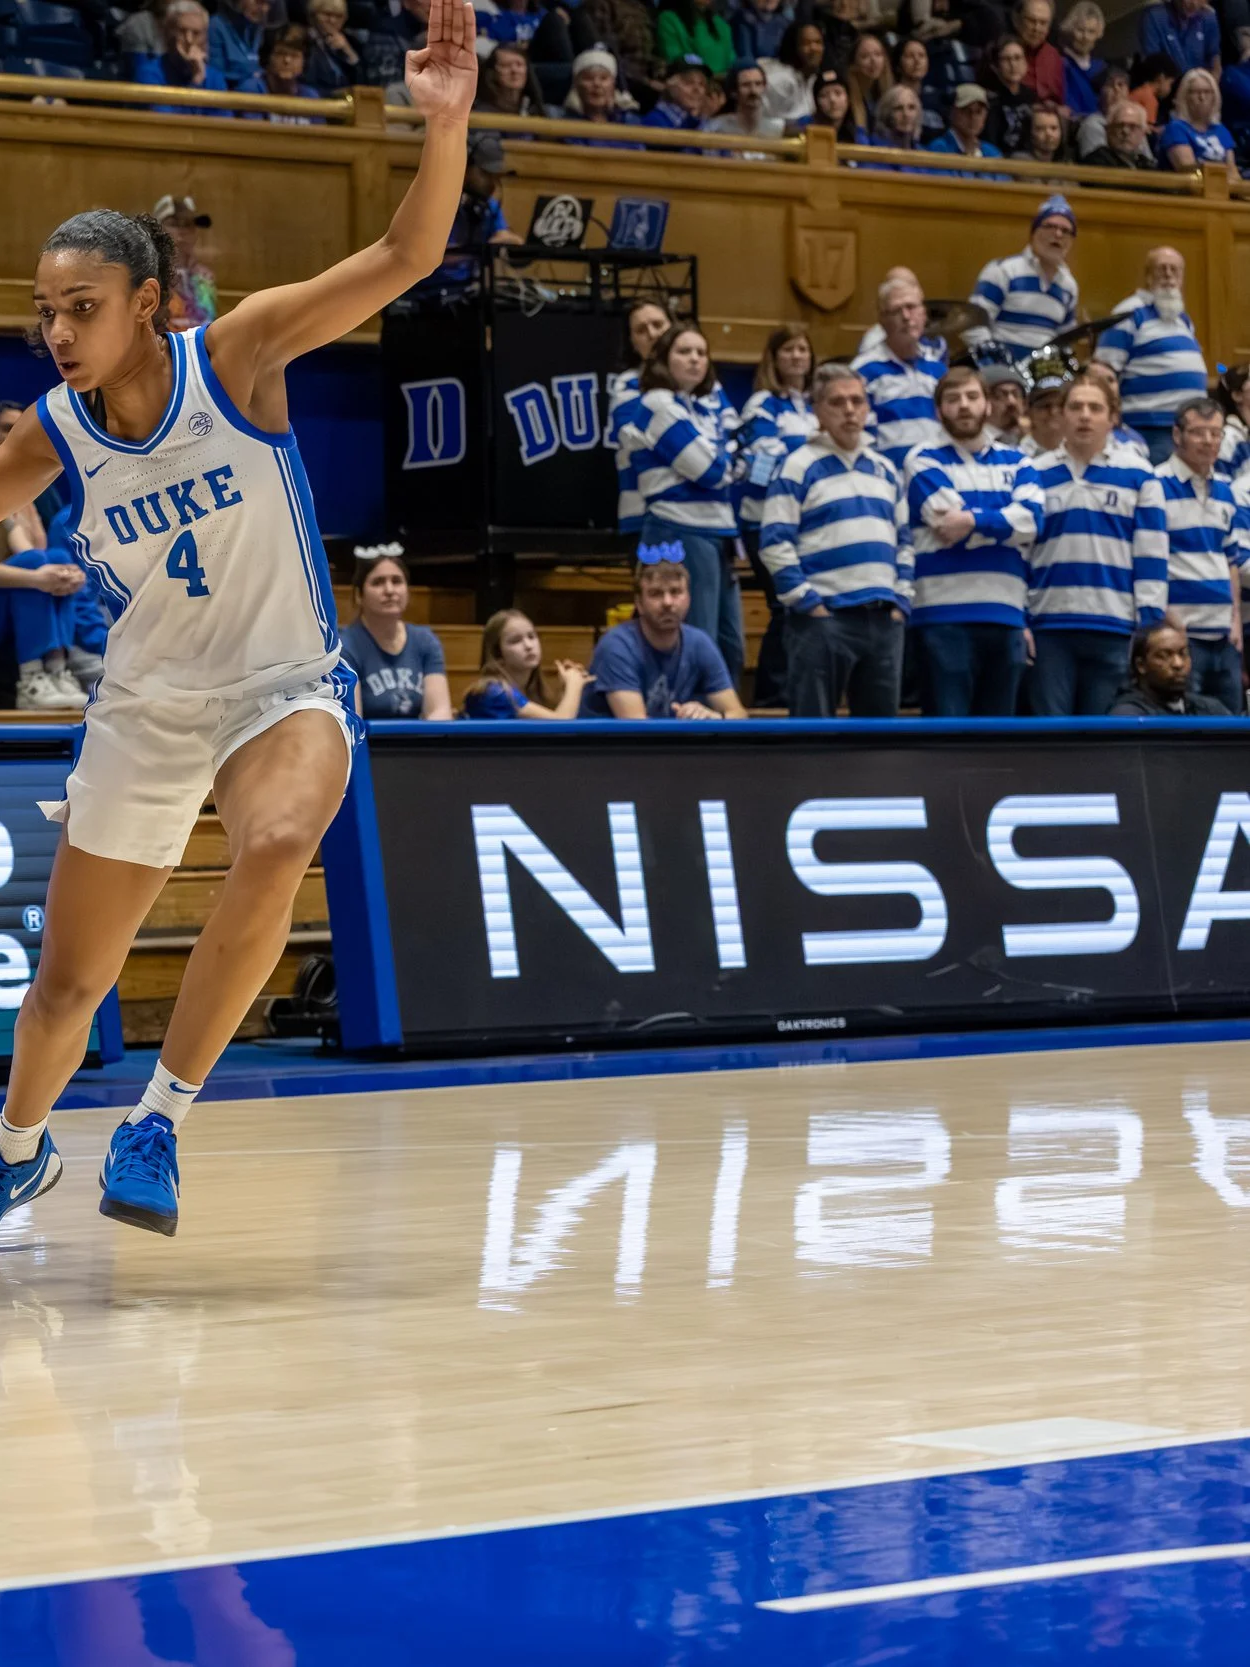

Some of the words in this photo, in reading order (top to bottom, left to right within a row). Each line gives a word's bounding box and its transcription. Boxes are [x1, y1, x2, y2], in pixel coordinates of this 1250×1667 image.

[400, 377, 466, 470] D
[504, 372, 619, 466] DU
[104, 464, 243, 545] DUKE
[166, 530, 210, 597] 4
[471, 791, 1250, 979] NISSA
